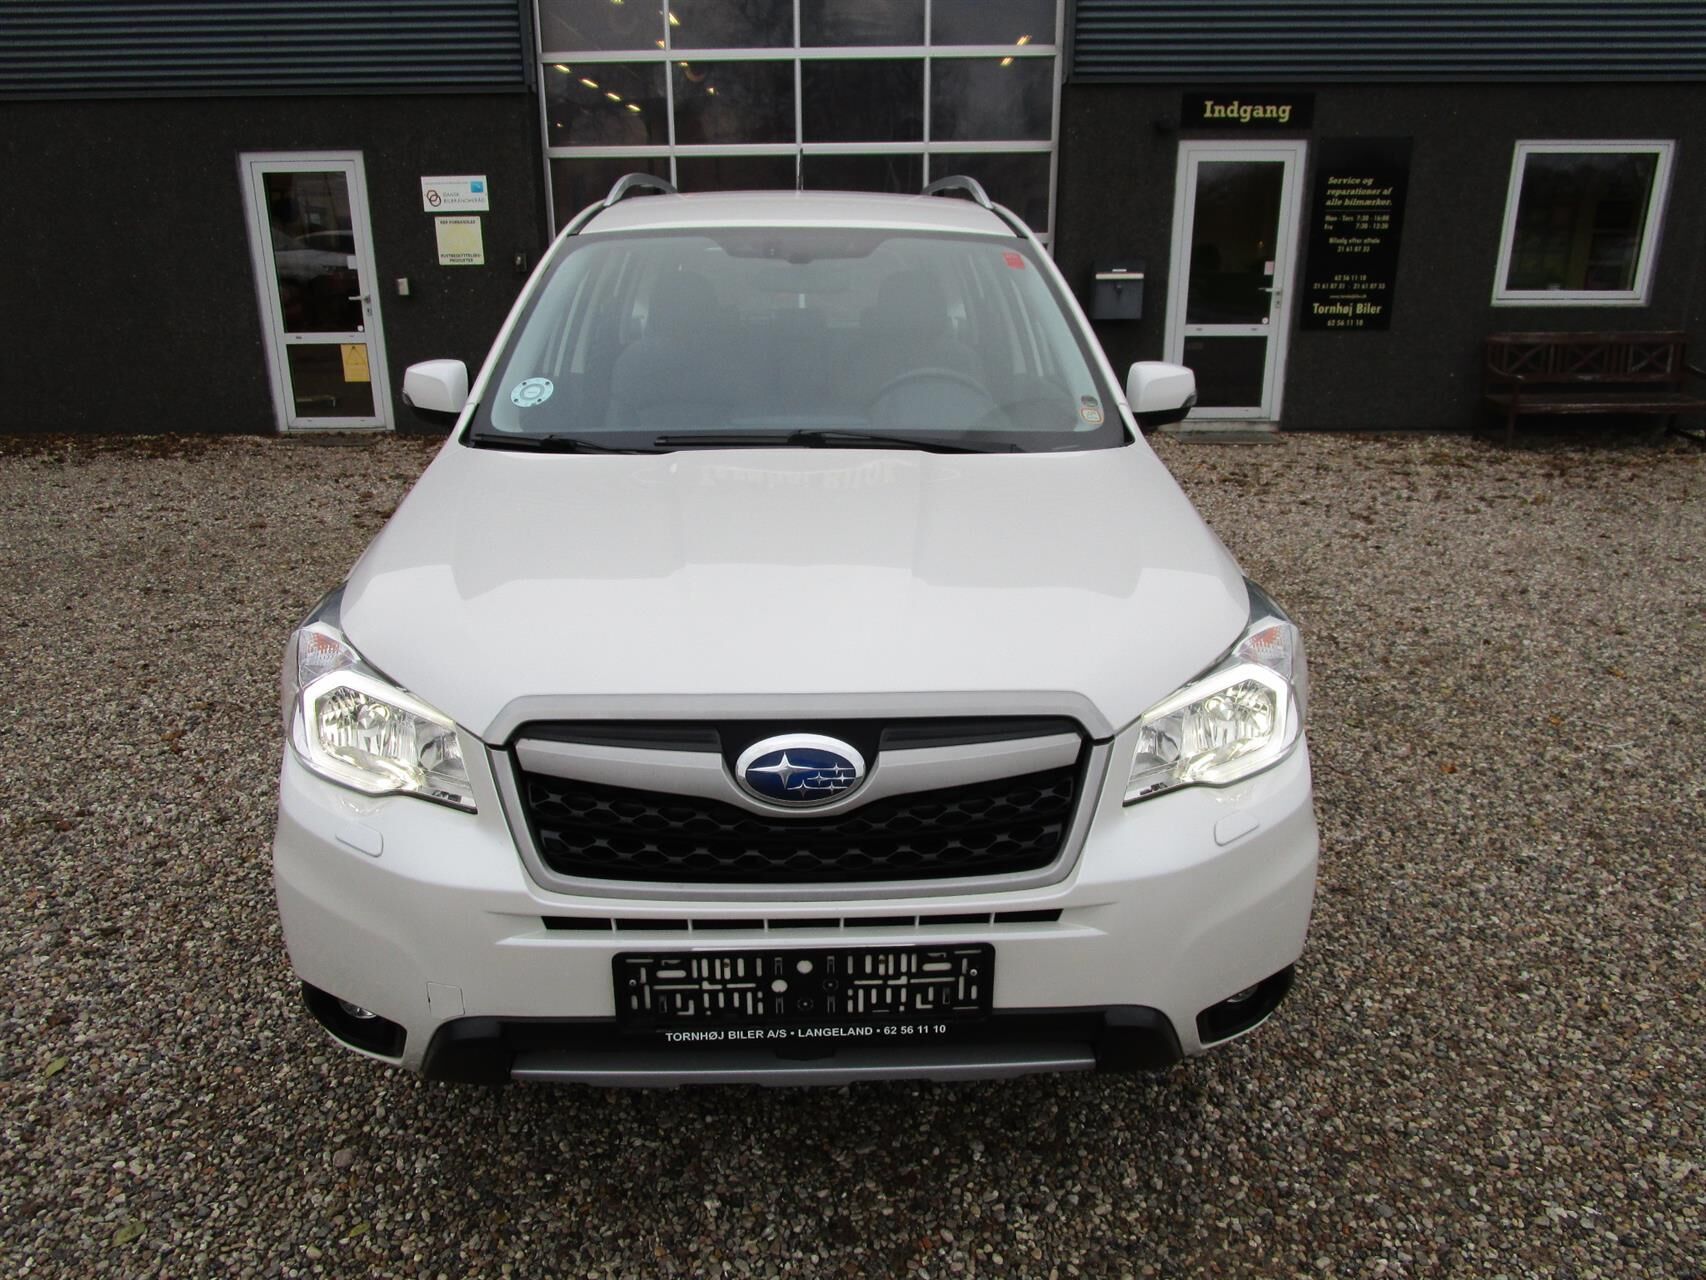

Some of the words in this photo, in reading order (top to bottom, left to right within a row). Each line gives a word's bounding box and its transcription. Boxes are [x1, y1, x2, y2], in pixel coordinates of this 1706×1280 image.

[1203, 100, 1293, 123] Indgang
[1327, 176, 1361, 185] Service
[1362, 178, 1374, 186] og
[1327, 188, 1381, 196] reparationer
[1382, 187, 1393, 195] af
[1325, 198, 1343, 206] alle
[1312, 302, 1353, 317] Tornhøj
[1356, 302, 1382, 314] Biler
[665, 1031, 725, 1042] TORNHØJ
[728, 1030, 764, 1040] BILER
[766, 1029, 787, 1039] A/S
[798, 1026, 874, 1038] LANGELAND
[883, 1025, 897, 1035] 62
[900, 1025, 914, 1035] 56
[917, 1025, 930, 1034] 11
[932, 1024, 947, 1034] 10
